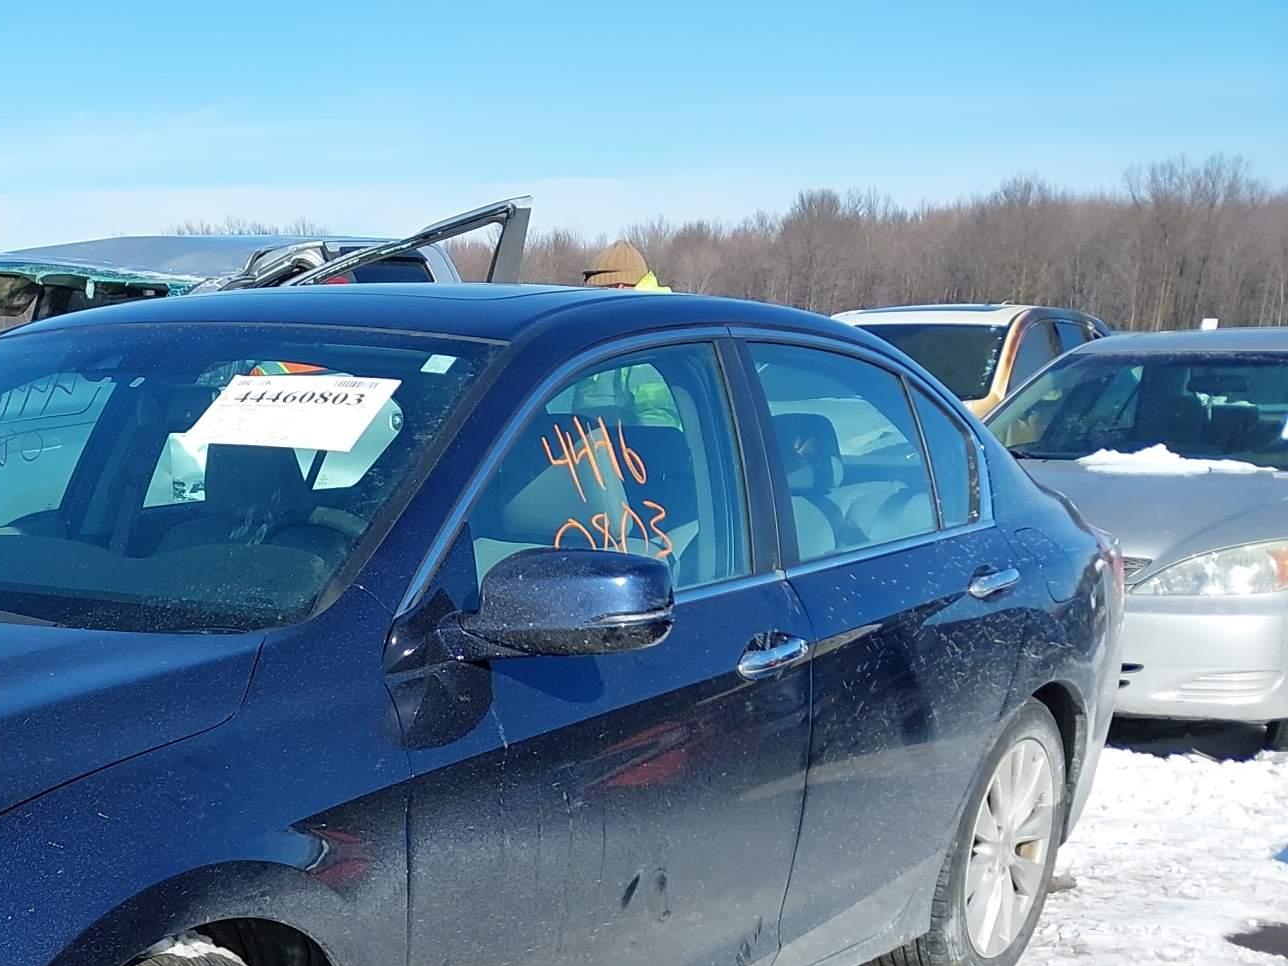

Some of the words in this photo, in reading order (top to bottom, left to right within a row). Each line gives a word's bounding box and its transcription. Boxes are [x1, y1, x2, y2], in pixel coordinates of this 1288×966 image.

[234, 390, 366, 407] 44460803
[541, 416, 648, 503] 4446
[554, 499, 673, 558] 0803
